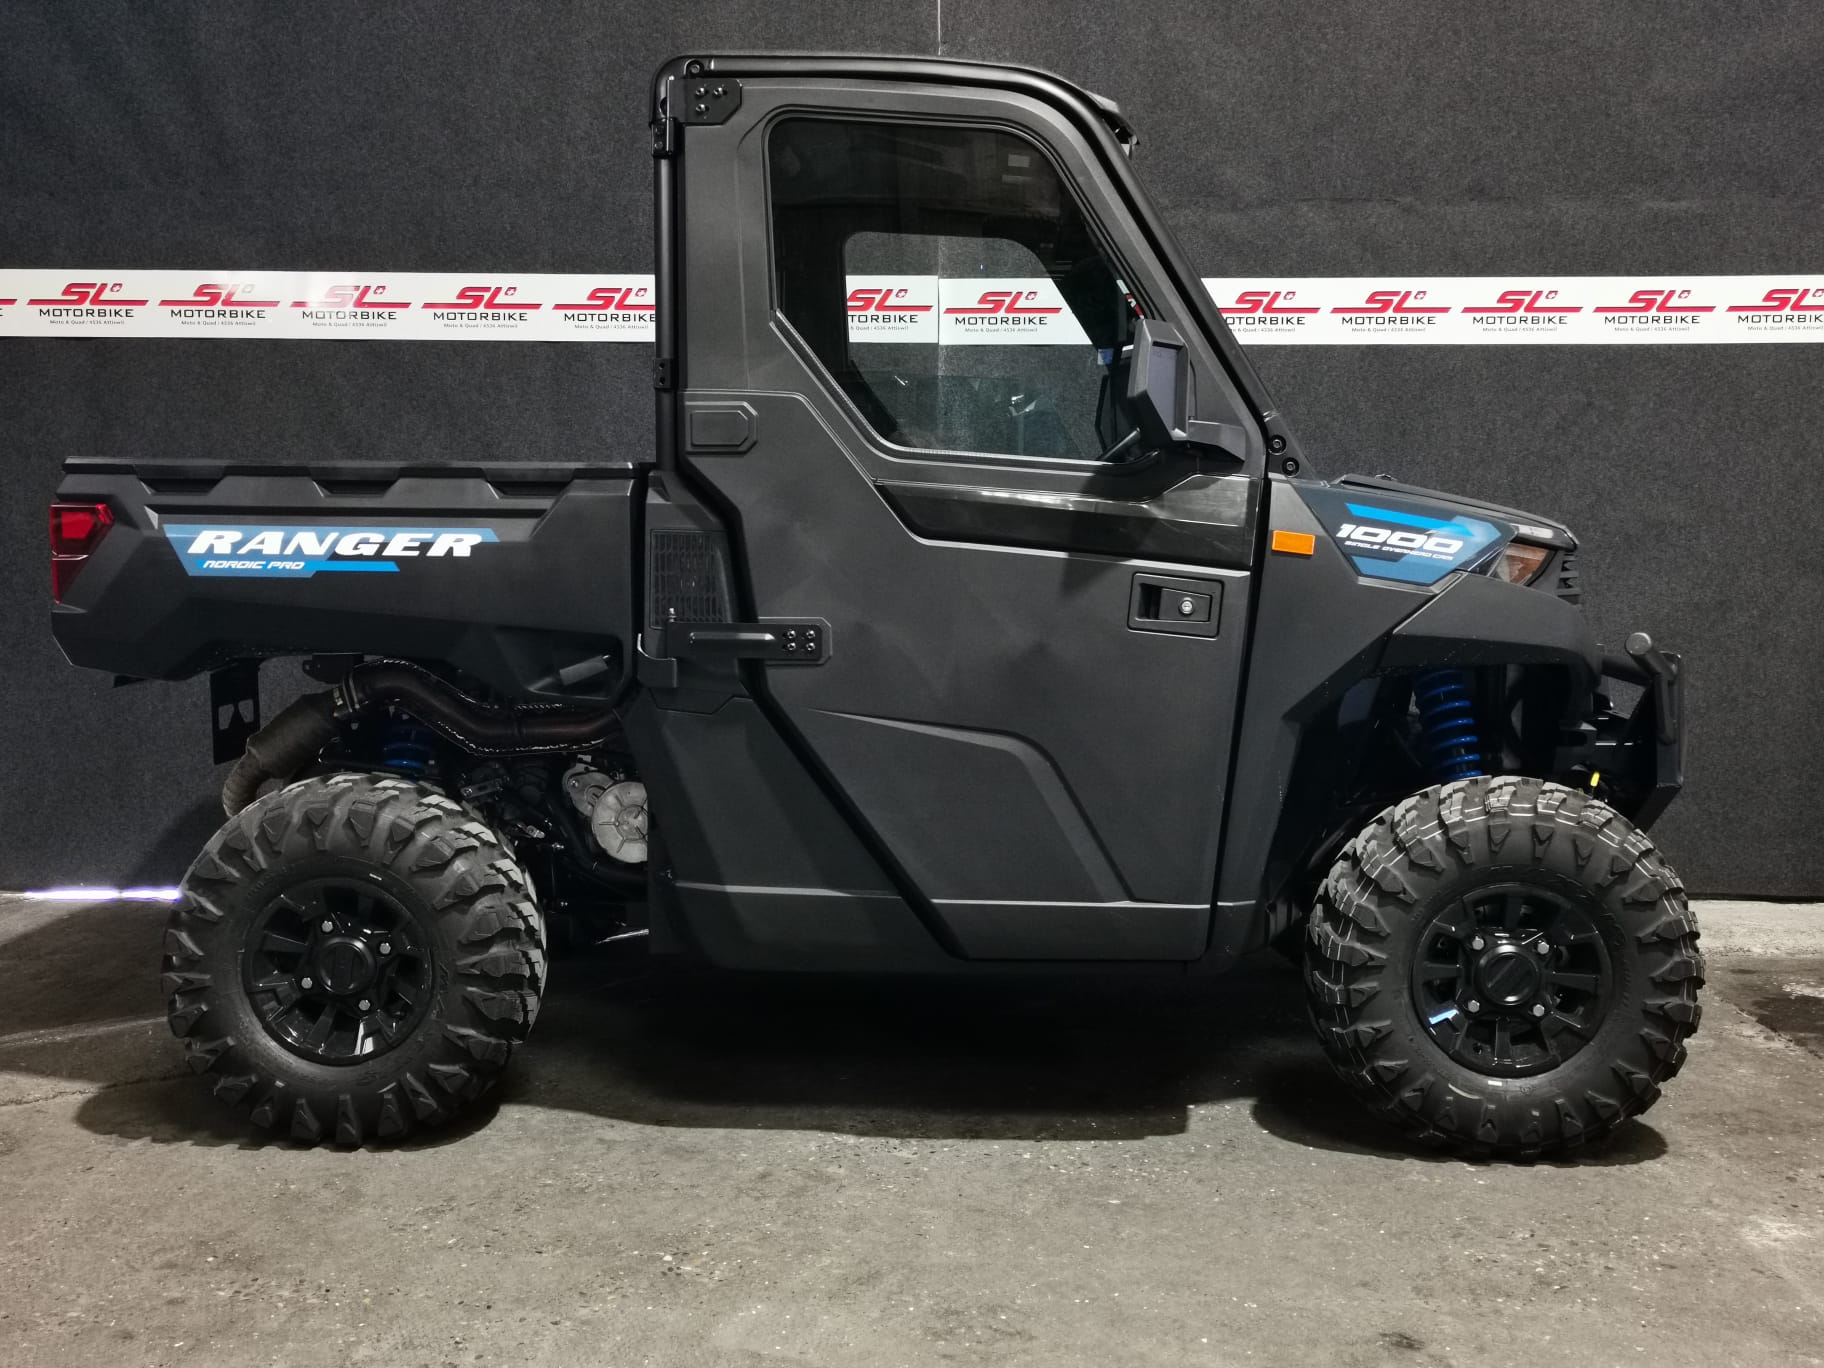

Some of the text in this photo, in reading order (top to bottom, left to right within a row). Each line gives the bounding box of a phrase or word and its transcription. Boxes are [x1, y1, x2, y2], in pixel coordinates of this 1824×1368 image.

[39, 308, 135, 317] MOTORBIKE
[170, 309, 266, 318] MOTORBIKE
[302, 311, 397, 320] MOTORBIKE
[434, 312, 528, 321] MOTORBIKE
[848, 315, 918, 323] TORBIKE
[955, 317, 1048, 325] MOTORBIKE
[1225, 317, 1306, 325] OTORBIKE
[1342, 316, 1436, 325] MOTORBIKE
[1473, 316, 1568, 324] MOTORBIKE
[1604, 316, 1701, 324] MOTORBIKE
[1738, 314, 1824, 323] MOTORBIK
[1336, 523, 1464, 554] 1000
[187, 530, 483, 557] RANGER
[203, 560, 306, 570] NORDIC PRO
